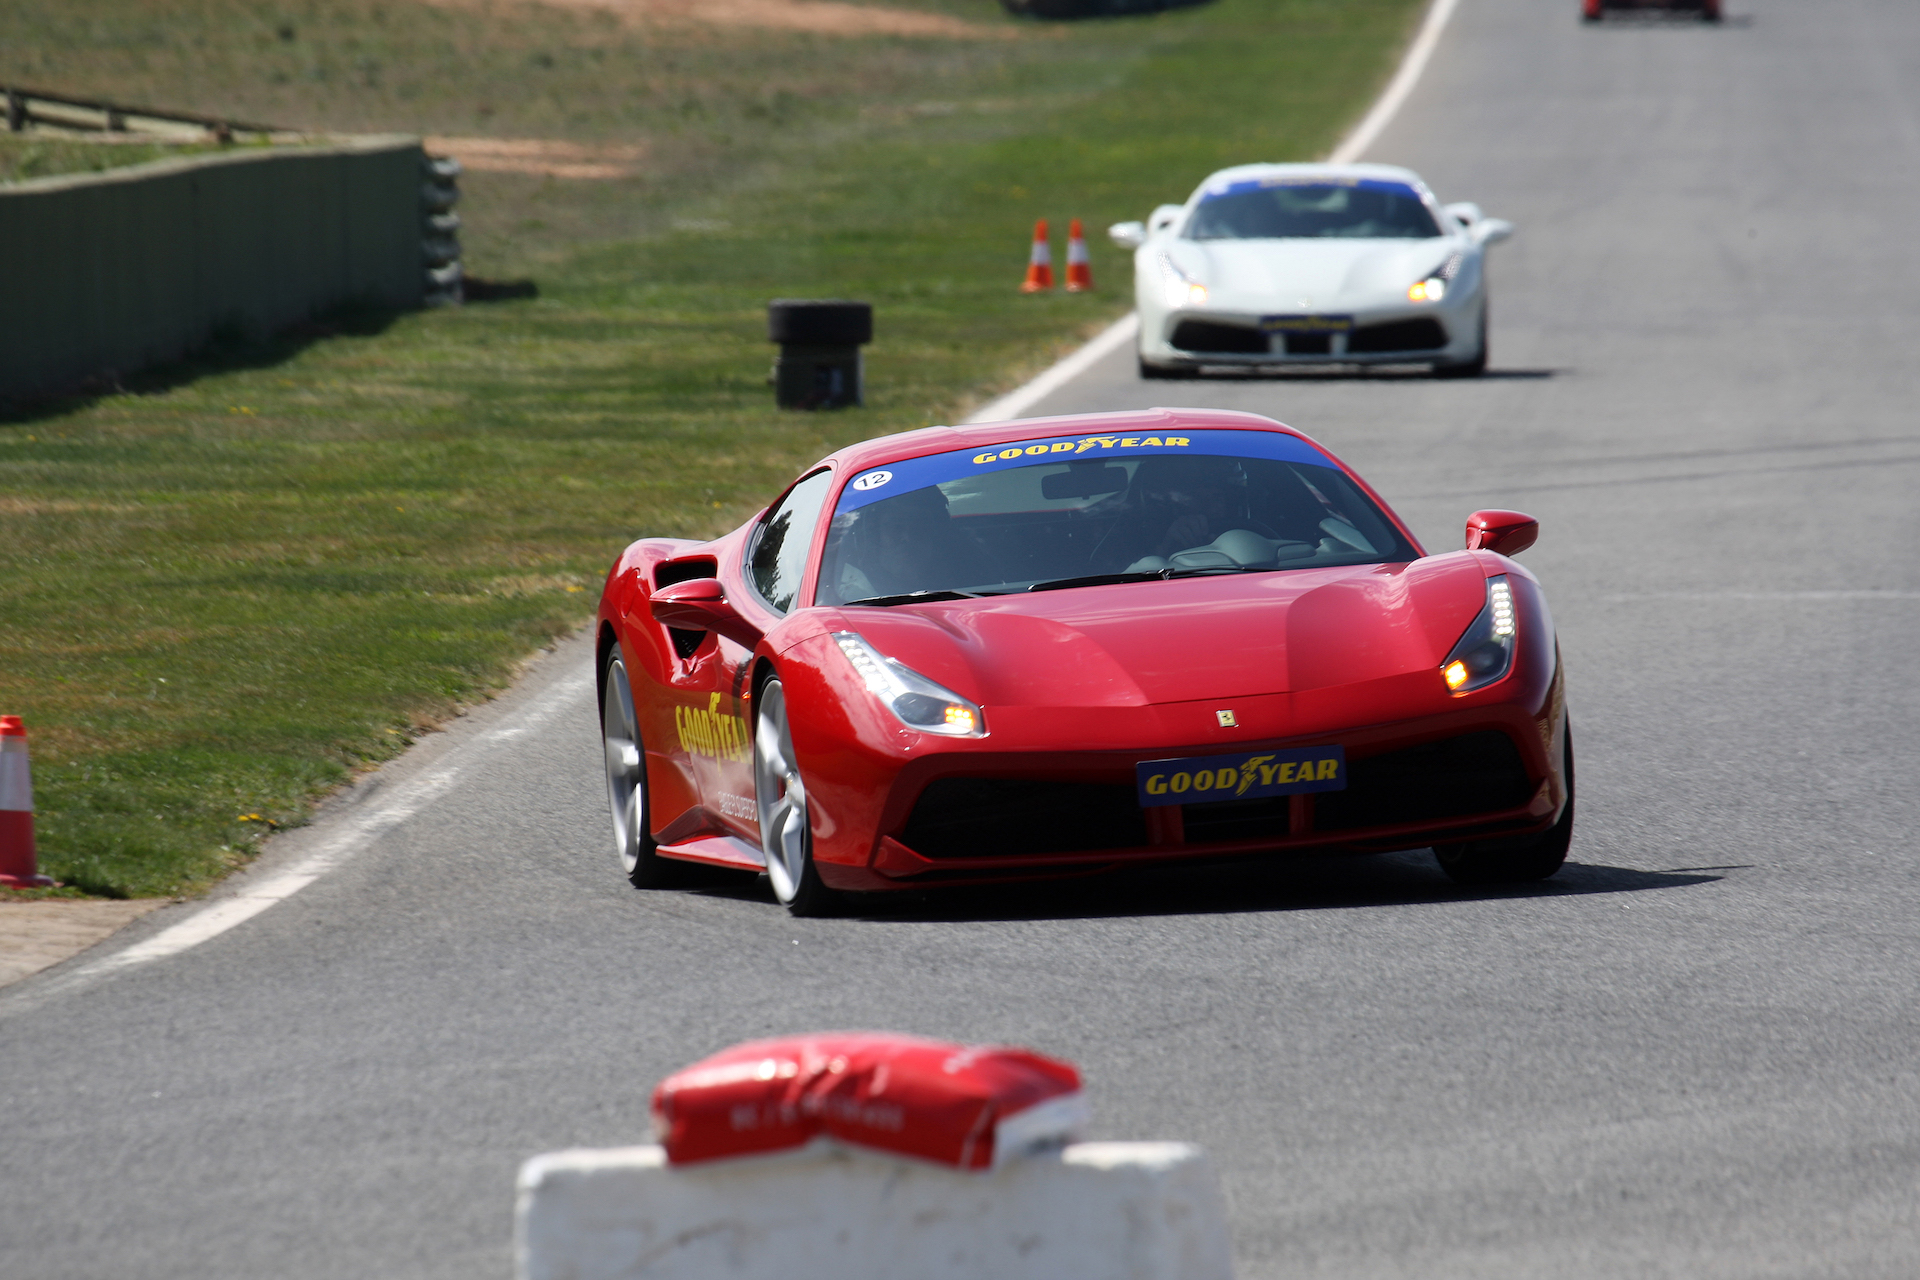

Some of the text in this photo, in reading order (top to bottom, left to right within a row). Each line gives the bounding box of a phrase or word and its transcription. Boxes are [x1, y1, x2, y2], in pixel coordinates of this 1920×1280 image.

[972, 436, 1190, 464] GOODYEAR
[859, 473, 886, 487] 12
[1146, 756, 1338, 796] GOODYEAR
